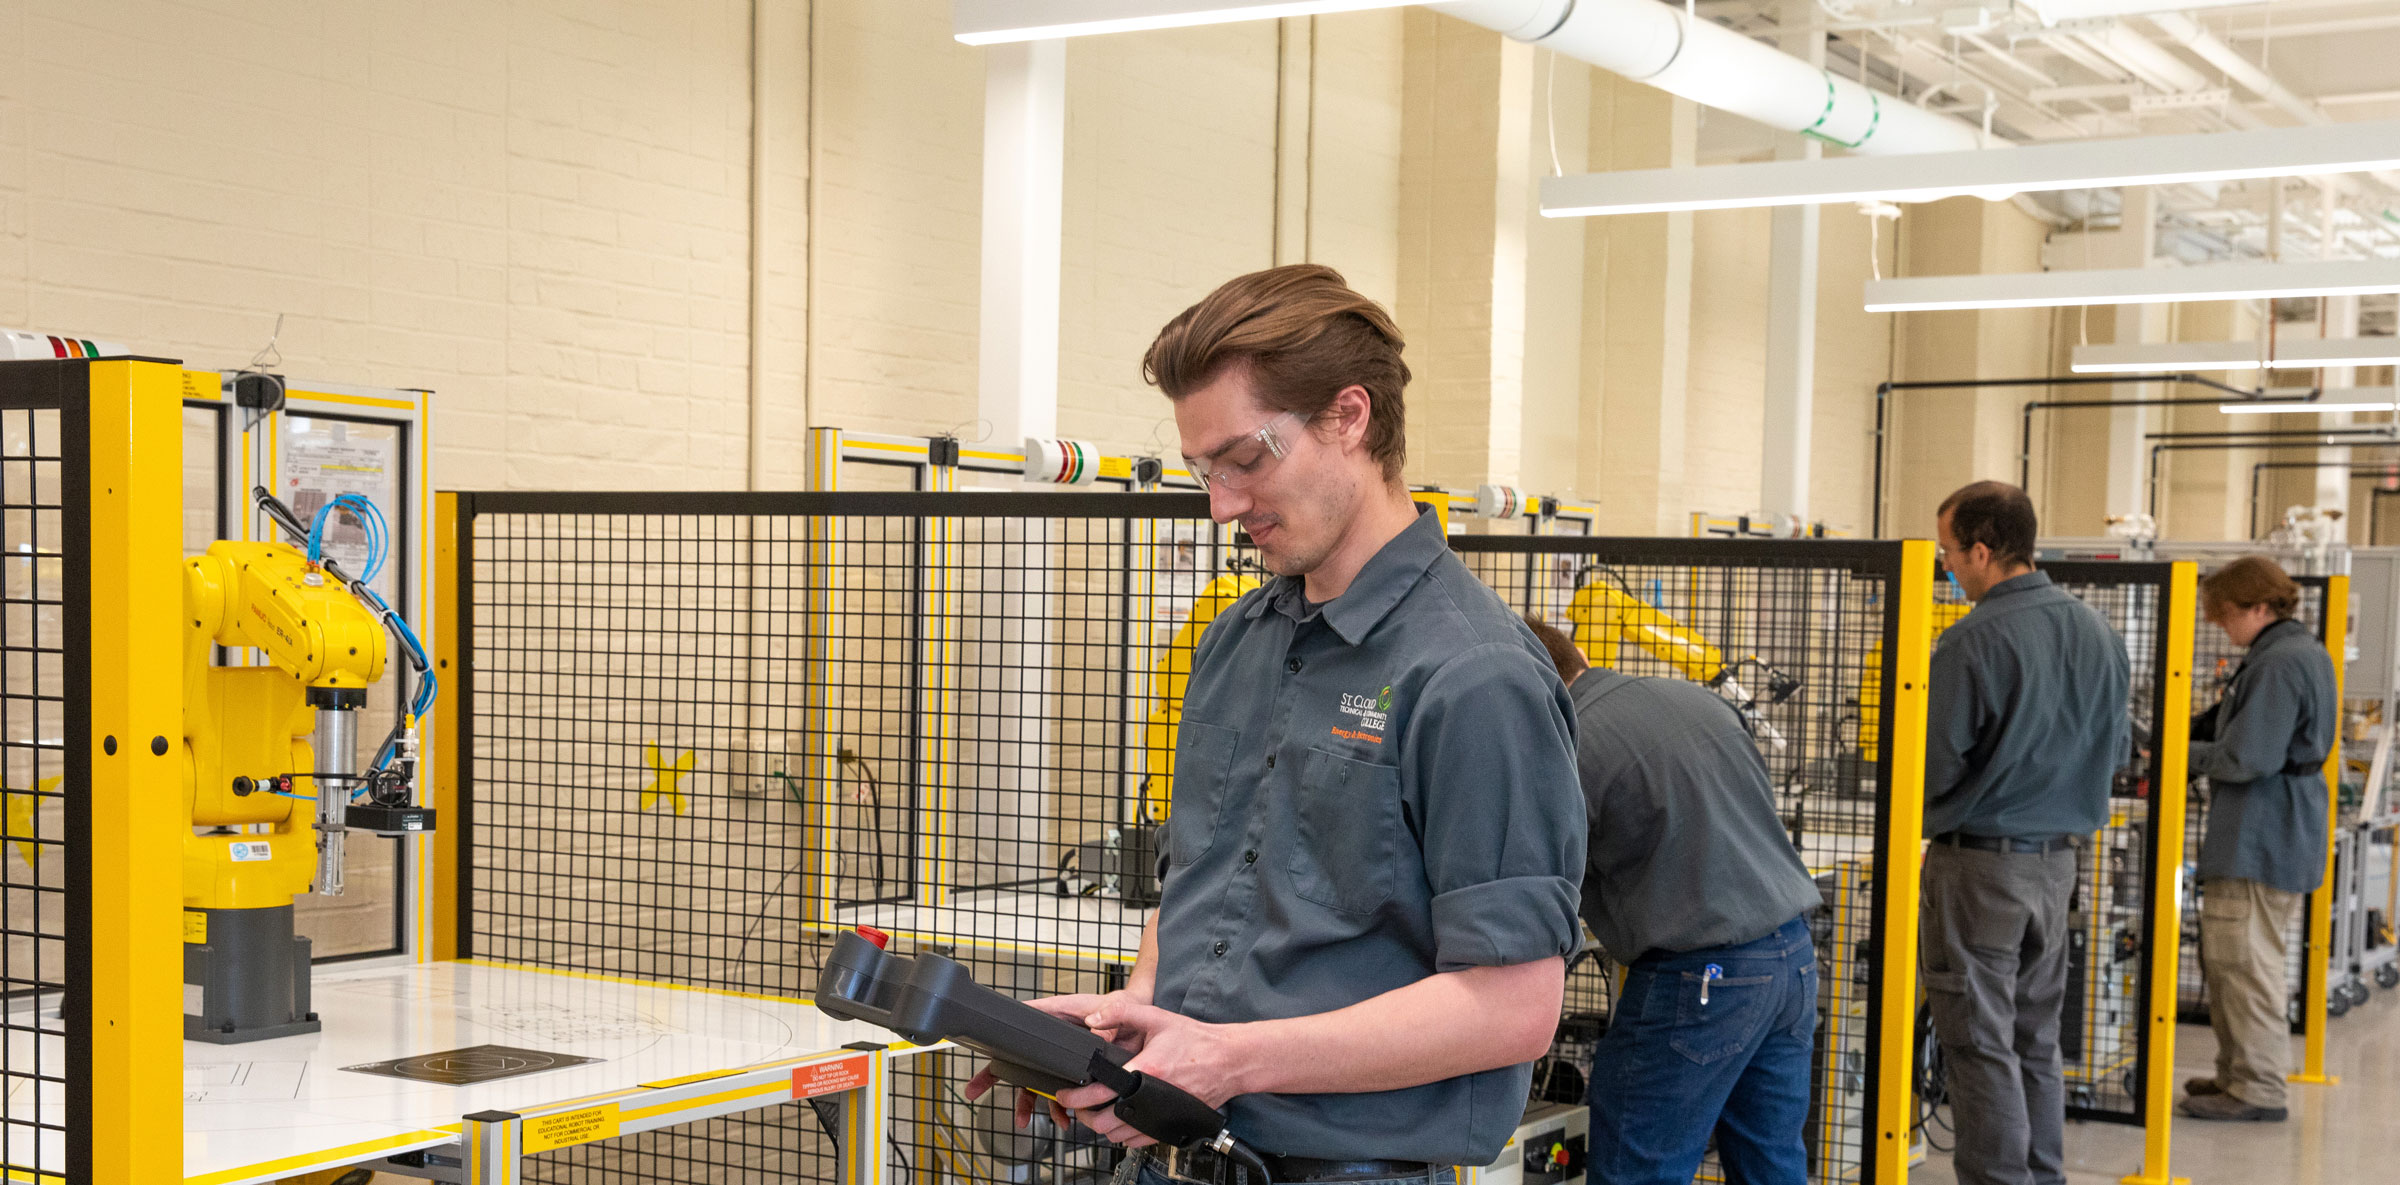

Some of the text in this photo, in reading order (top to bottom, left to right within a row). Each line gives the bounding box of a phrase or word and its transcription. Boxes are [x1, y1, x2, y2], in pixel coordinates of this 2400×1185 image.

[251, 602, 266, 623] FANUC
[1360, 718, 1385, 730] COLLEGE
[819, 1063, 843, 1073] WARNING
[570, 1112, 592, 1120] INTENDED
[538, 1125, 567, 1134] EDUCATIONAL
[564, 1126, 592, 1136] COMMERCIAL
[554, 1136, 579, 1144] INDUSTRIAL
